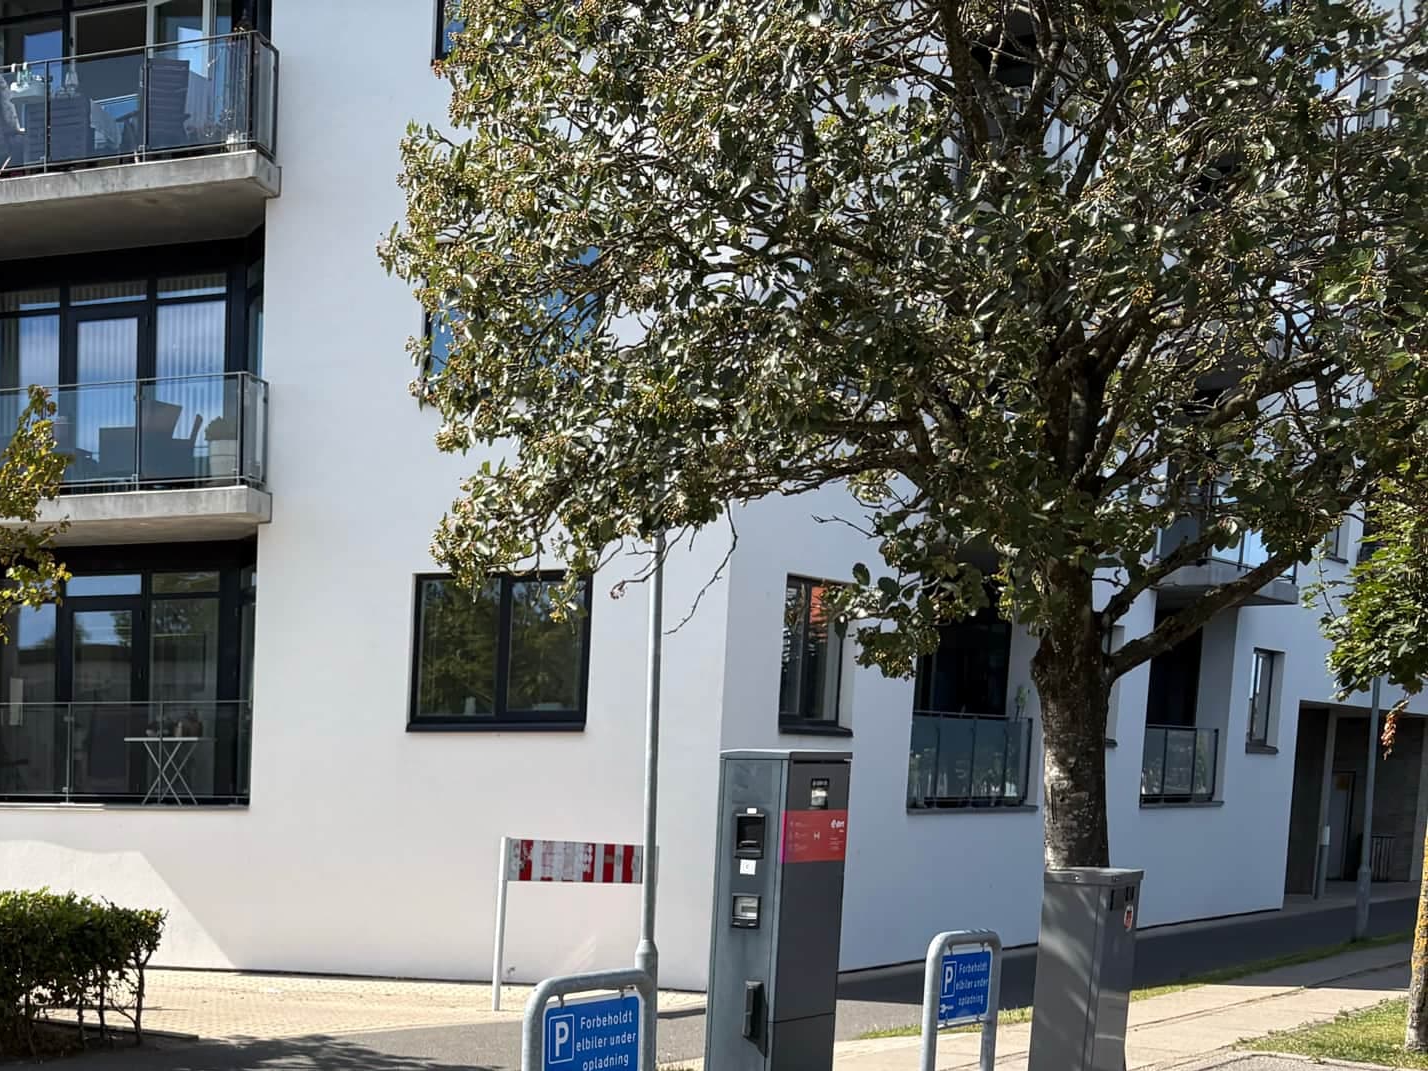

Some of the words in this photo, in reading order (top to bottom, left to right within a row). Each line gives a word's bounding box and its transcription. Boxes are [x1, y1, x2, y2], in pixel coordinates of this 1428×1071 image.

[945, 966, 953, 993] P
[580, 1010, 633, 1030] Forbeholdt
[556, 1022, 569, 1057] P
[576, 1036, 607, 1051] elbiler
[610, 1031, 636, 1046] under
[582, 1053, 629, 1071] opladning
